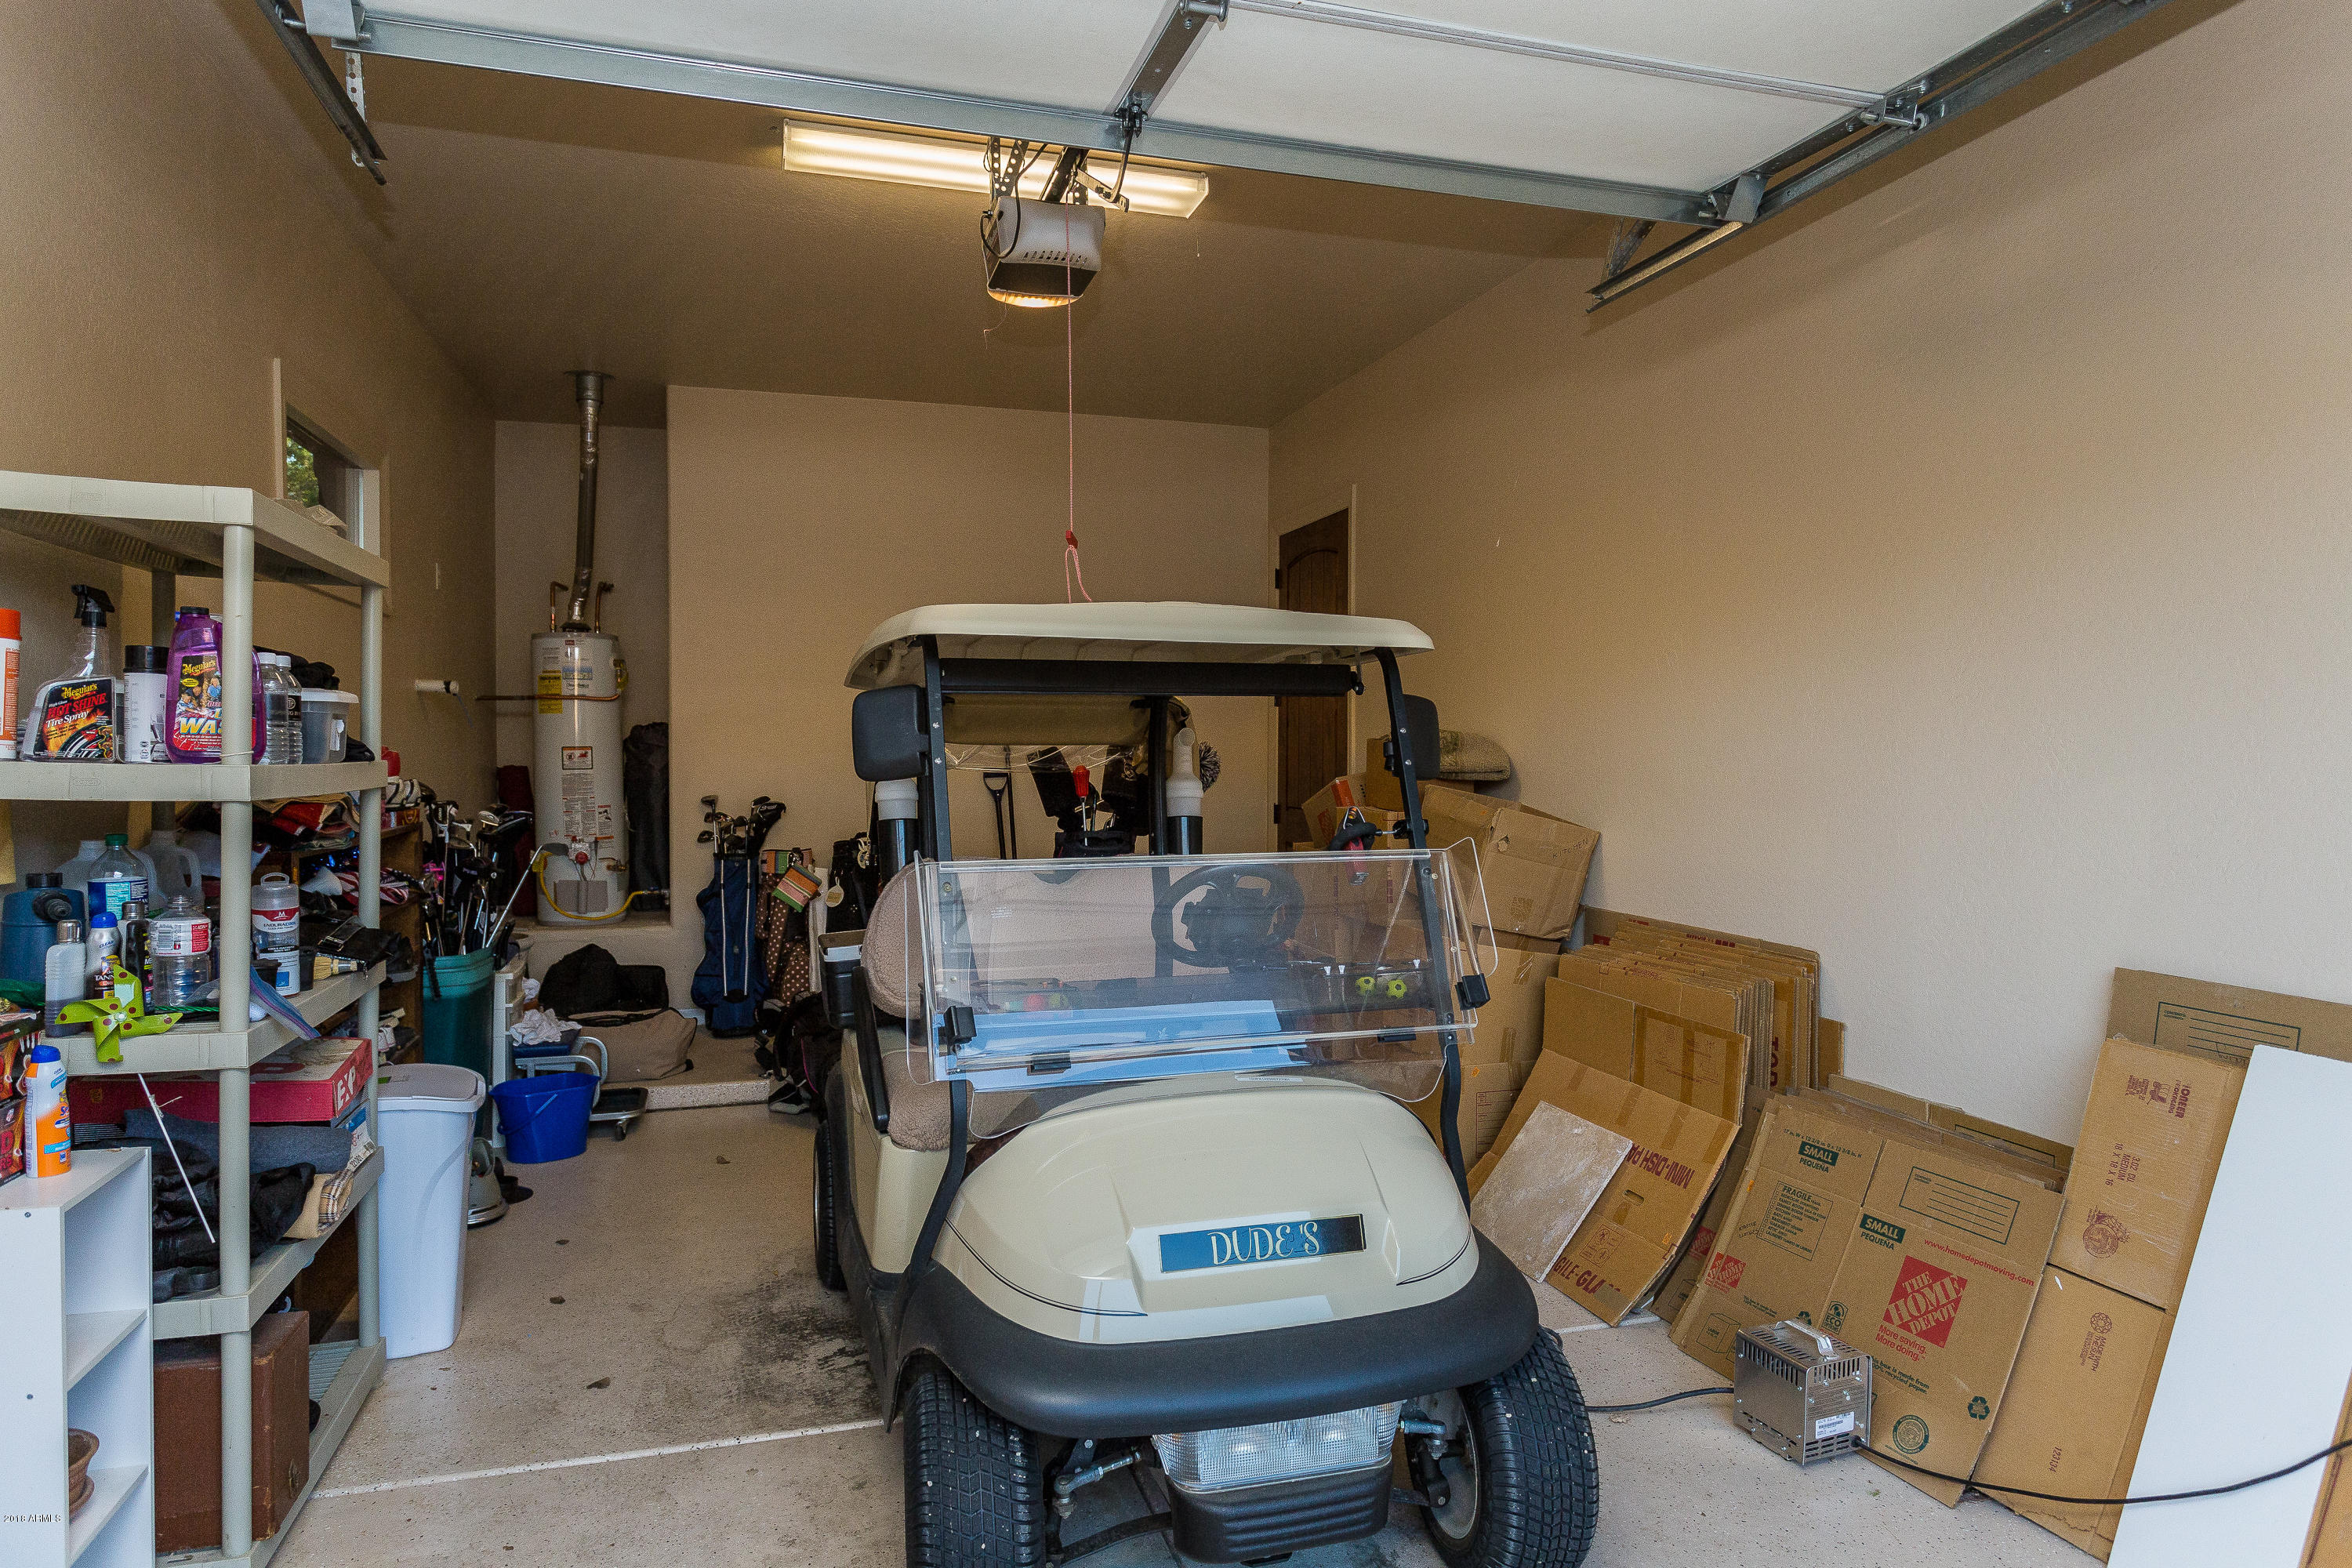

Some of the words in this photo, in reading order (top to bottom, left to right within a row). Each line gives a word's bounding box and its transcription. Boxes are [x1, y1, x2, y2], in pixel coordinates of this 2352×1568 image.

[61, 683, 98, 699] Meguiar's
[47, 703, 72, 719] HOT
[72, 693, 107, 712] SHINE
[46, 718, 64, 728] Tire
[64, 711, 89, 723] Spray
[180, 717, 222, 735] WA
[1626, 1142, 1646, 1166] PA
[1799, 1157, 1829, 1174] PEQUEÑA
[1803, 1145, 1832, 1163] SMALL
[2130, 1156, 2140, 1171] 3.02
[1639, 1149, 1695, 1189] MINI-DISH
[2117, 1153, 2131, 1181] MEDIUM
[2126, 1173, 2136, 1182] CU.
[1782, 1185, 1813, 1202] FRAGILE
[1860, 1231, 1895, 1250] PEQUEÑA
[1864, 1218, 1900, 1240] SMALL
[1207, 1221, 1320, 1265] DUDE'S
[1924, 1239, 2034, 1287] www.homedepotmoving.com
[1902, 1271, 1933, 1293] THE
[1888, 1274, 1965, 1327] HOME
[1825, 1315, 1842, 1327] ECO
[1908, 1301, 1956, 1334] DEPOT
[1875, 1333, 1895, 1348] More
[1896, 1344, 1919, 1362] doing.
[1878, 1323, 1898, 1340] More
[1900, 1335, 1926, 1354] saving.
[1880, 1358, 1892, 1370] box
[1898, 1368, 1914, 1382] made
[1915, 1376, 1929, 1388] from
[1885, 1368, 1908, 1387] recycled
[1908, 1381, 1928, 1395] paper.
